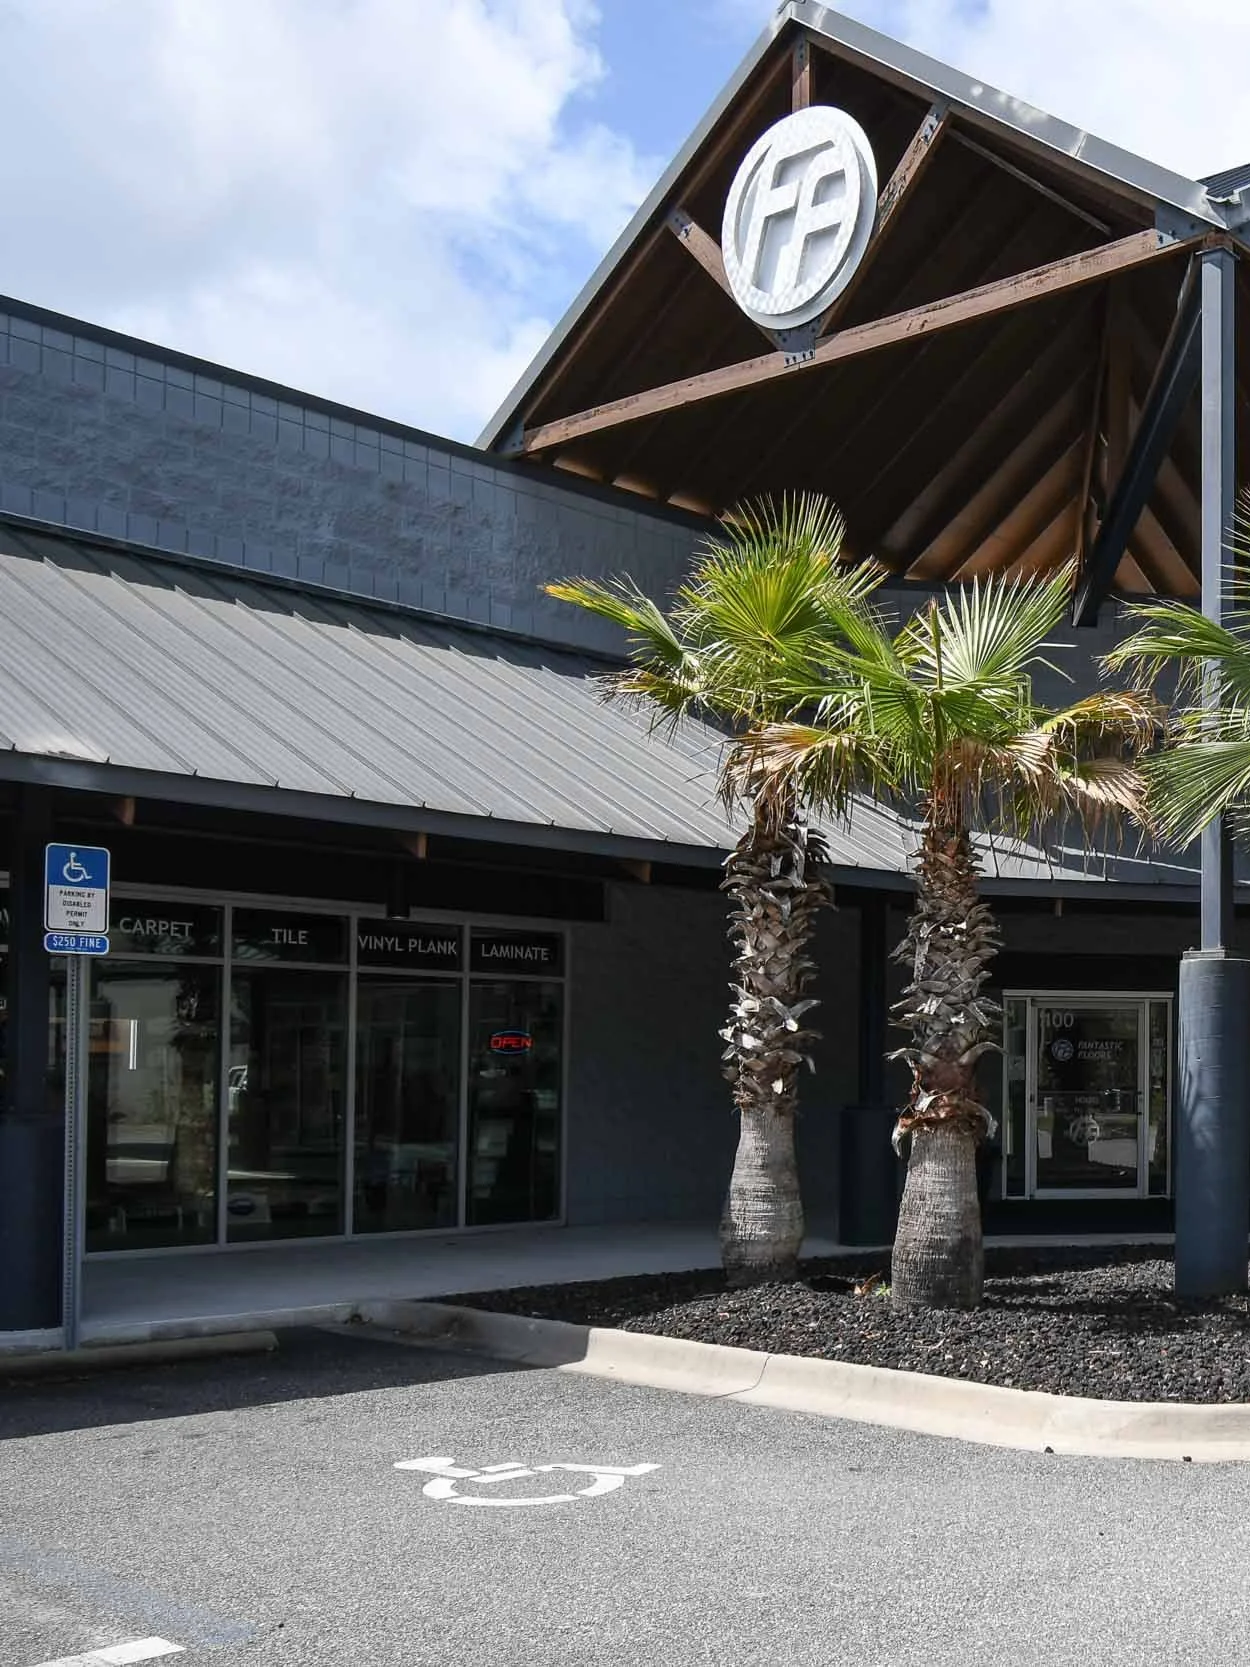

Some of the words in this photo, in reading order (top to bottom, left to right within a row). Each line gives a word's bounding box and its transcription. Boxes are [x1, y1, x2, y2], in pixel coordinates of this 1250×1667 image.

[59, 890, 86, 898] PARKING
[62, 900, 92, 908] DISABLED
[66, 910, 88, 918] PERMIT
[68, 920, 84, 928] ONLY
[119, 918, 194, 937] CARPET
[52, 935, 76, 947] $250
[80, 937, 101, 948] FINE
[271, 928, 309, 945] TILE
[358, 935, 405, 951] VINYL
[408, 938, 457, 955] PLANK
[481, 943, 550, 961] LAMINATE
[1043, 1012, 1074, 1029] 100
[490, 1036, 532, 1049] OPEN
